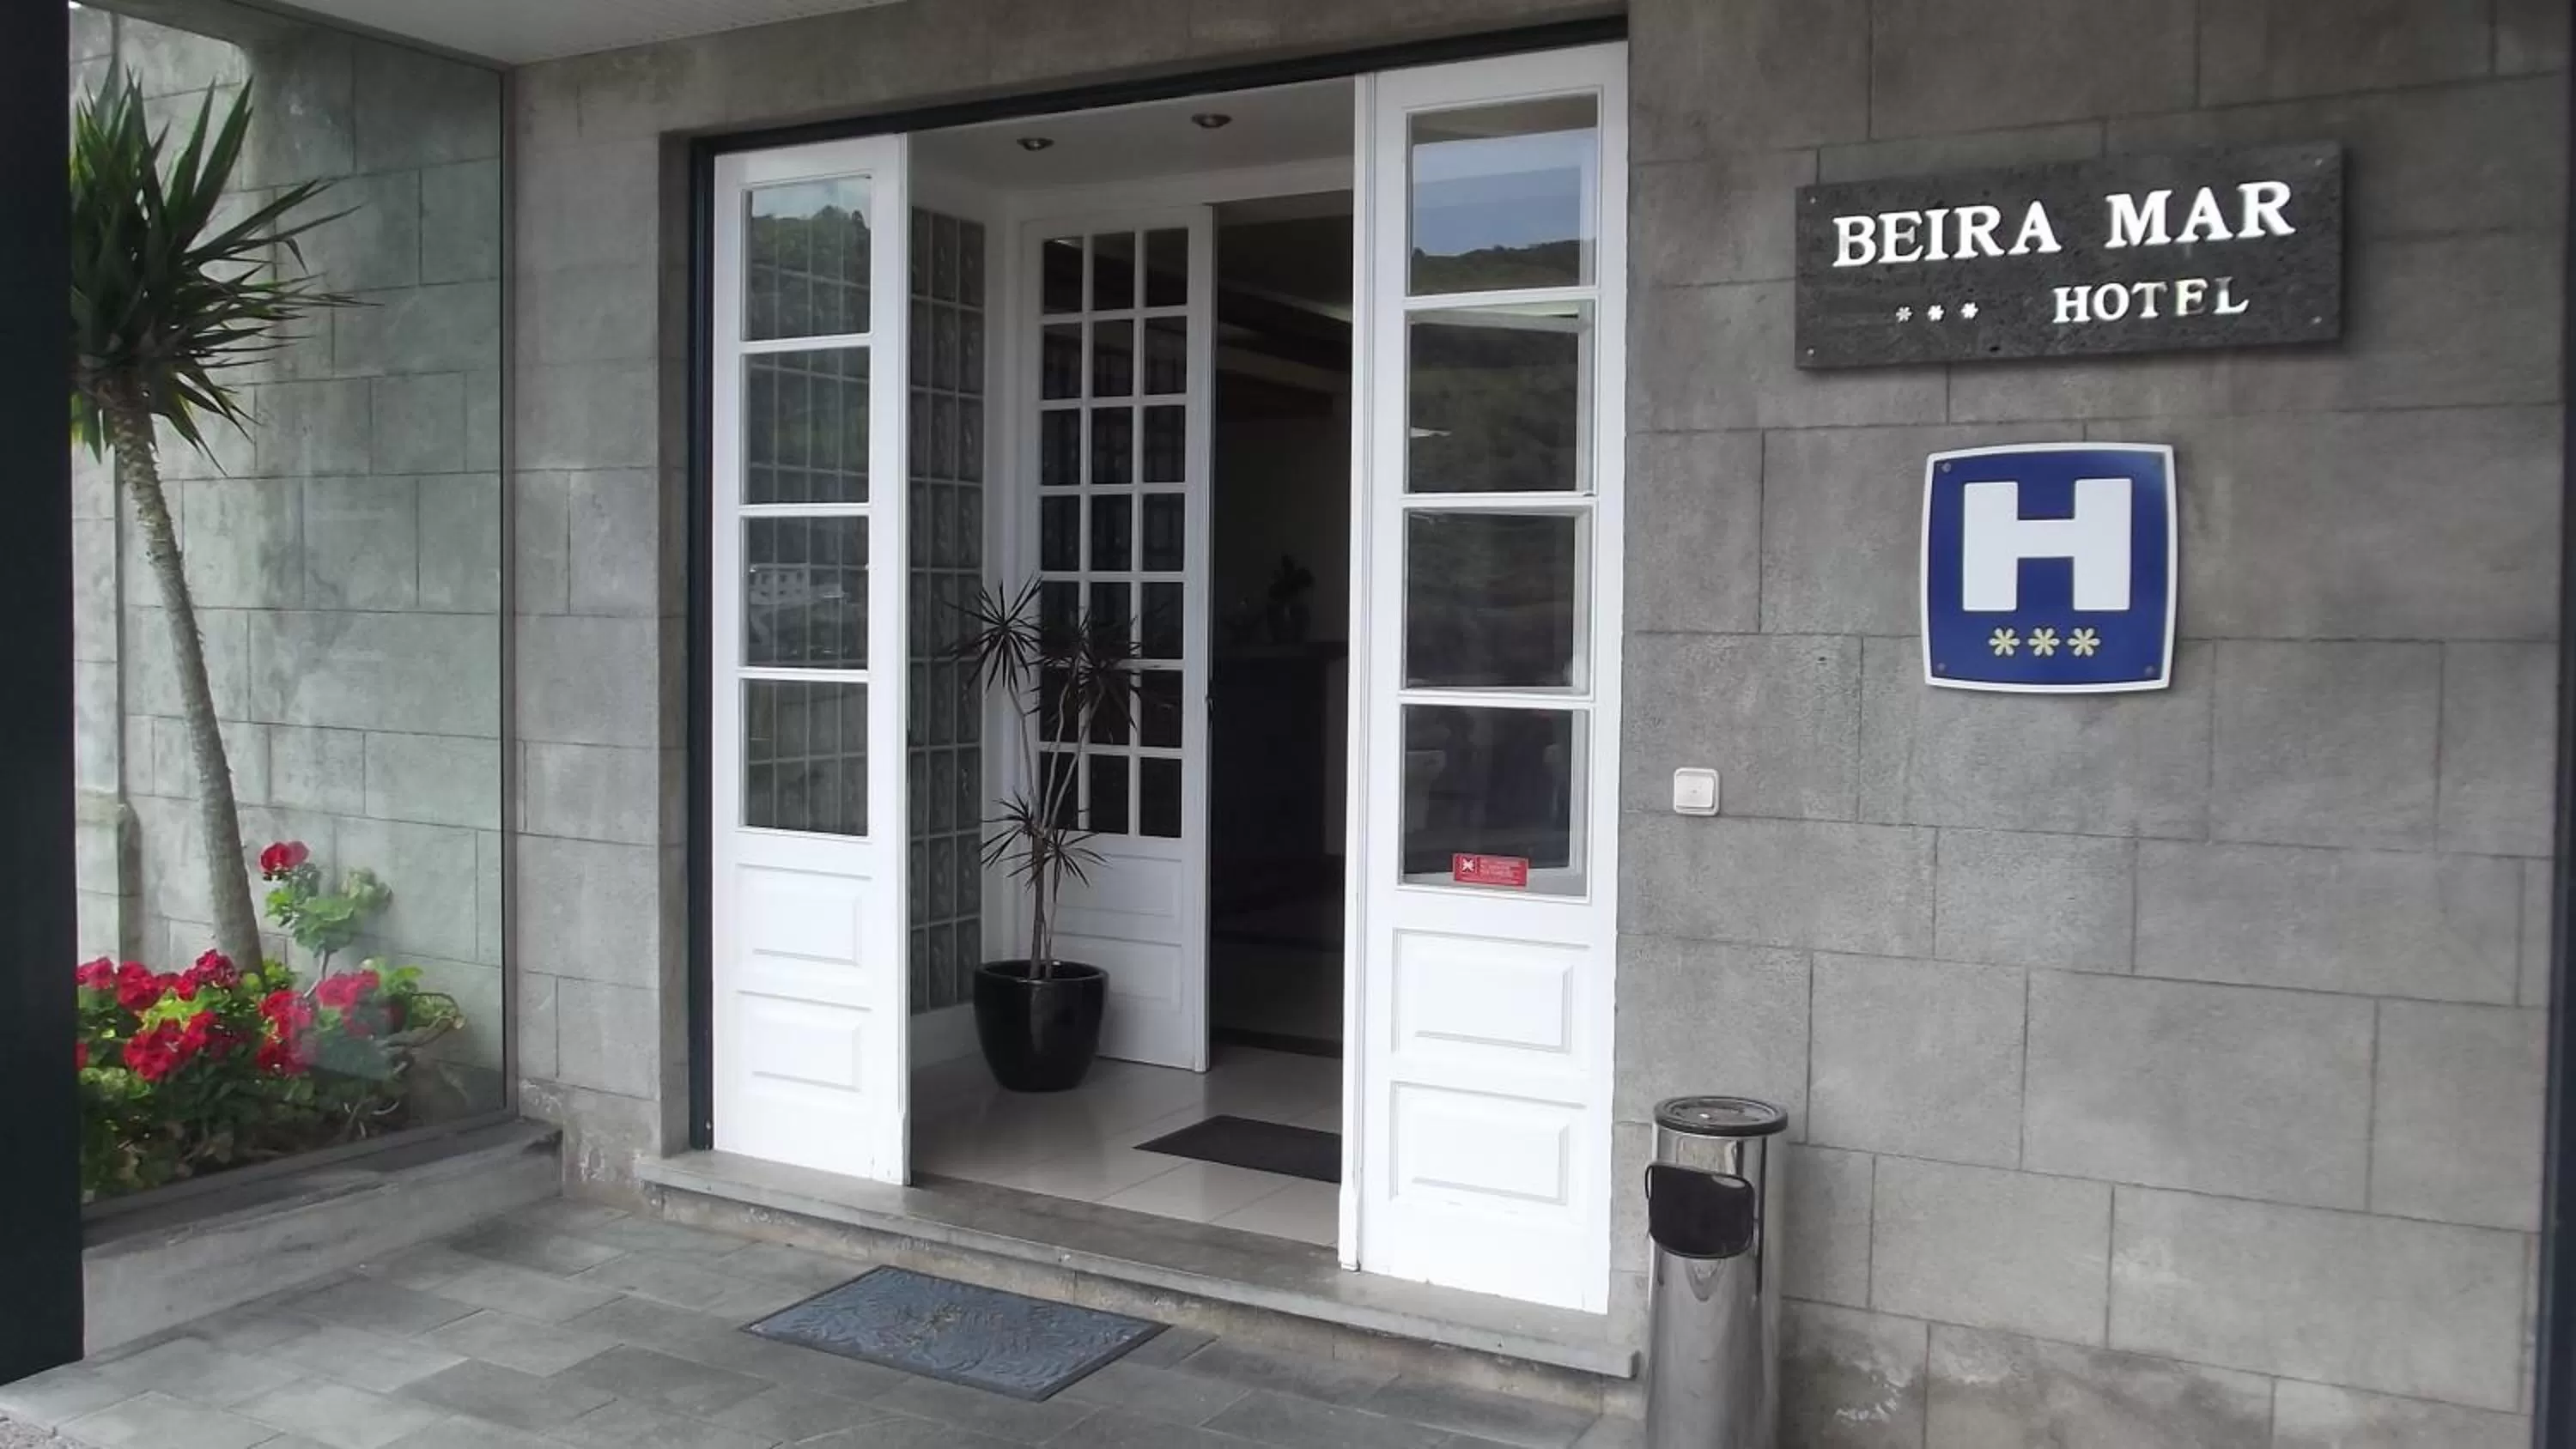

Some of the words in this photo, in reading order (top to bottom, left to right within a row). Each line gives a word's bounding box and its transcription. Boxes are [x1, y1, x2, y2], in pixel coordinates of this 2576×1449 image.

[1832, 199, 2062, 268] BEIRA
[2104, 179, 2295, 249] MAR
[2052, 276, 2250, 324] HOTEL
[1963, 478, 2131, 611] H
